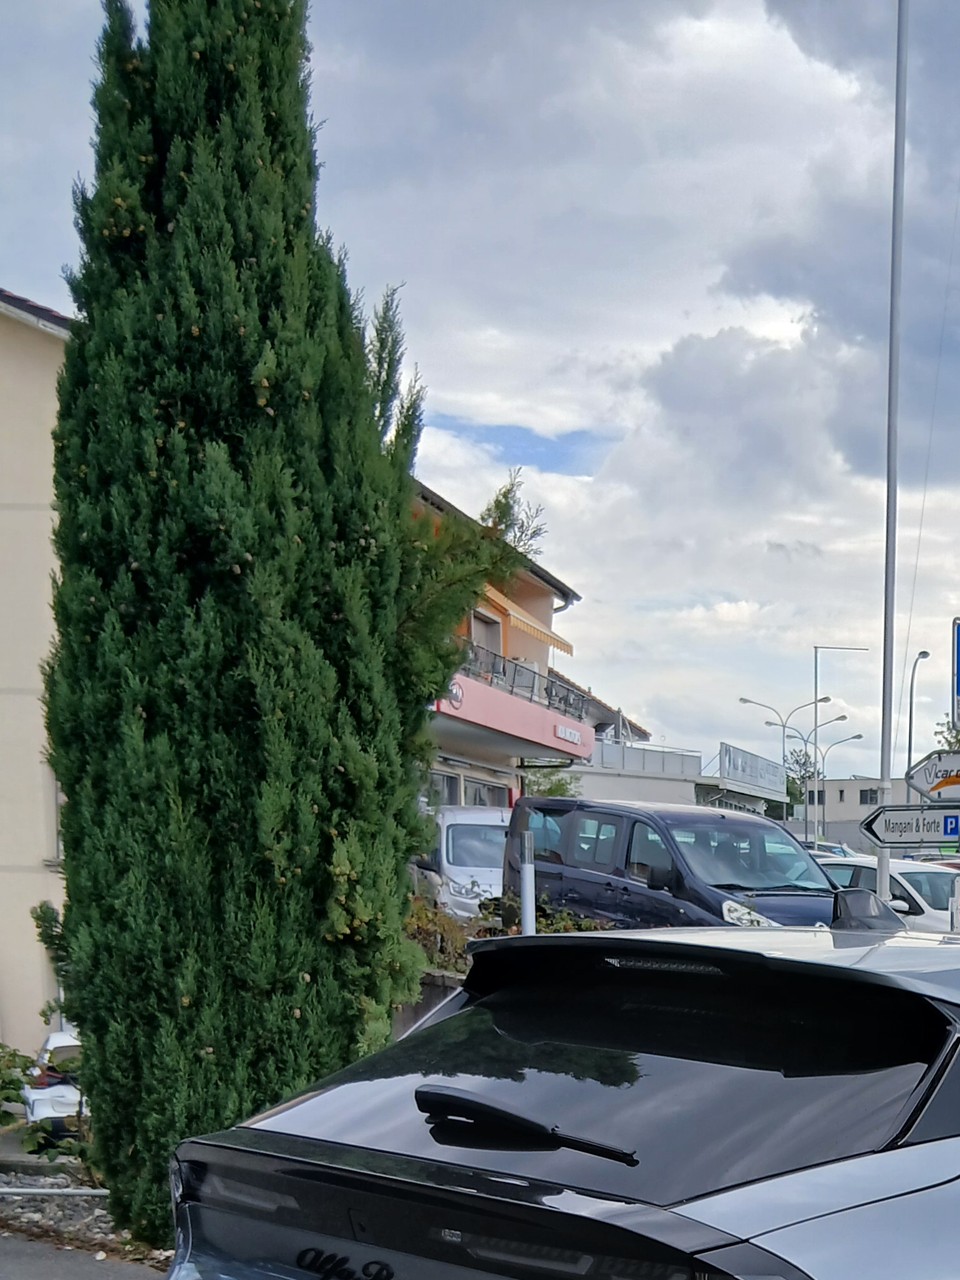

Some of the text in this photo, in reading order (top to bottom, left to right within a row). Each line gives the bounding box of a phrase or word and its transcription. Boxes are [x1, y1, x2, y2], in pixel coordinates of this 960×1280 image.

[884, 818, 914, 838] Mangani
[915, 817, 920, 833] &
[922, 817, 940, 833] Forte
